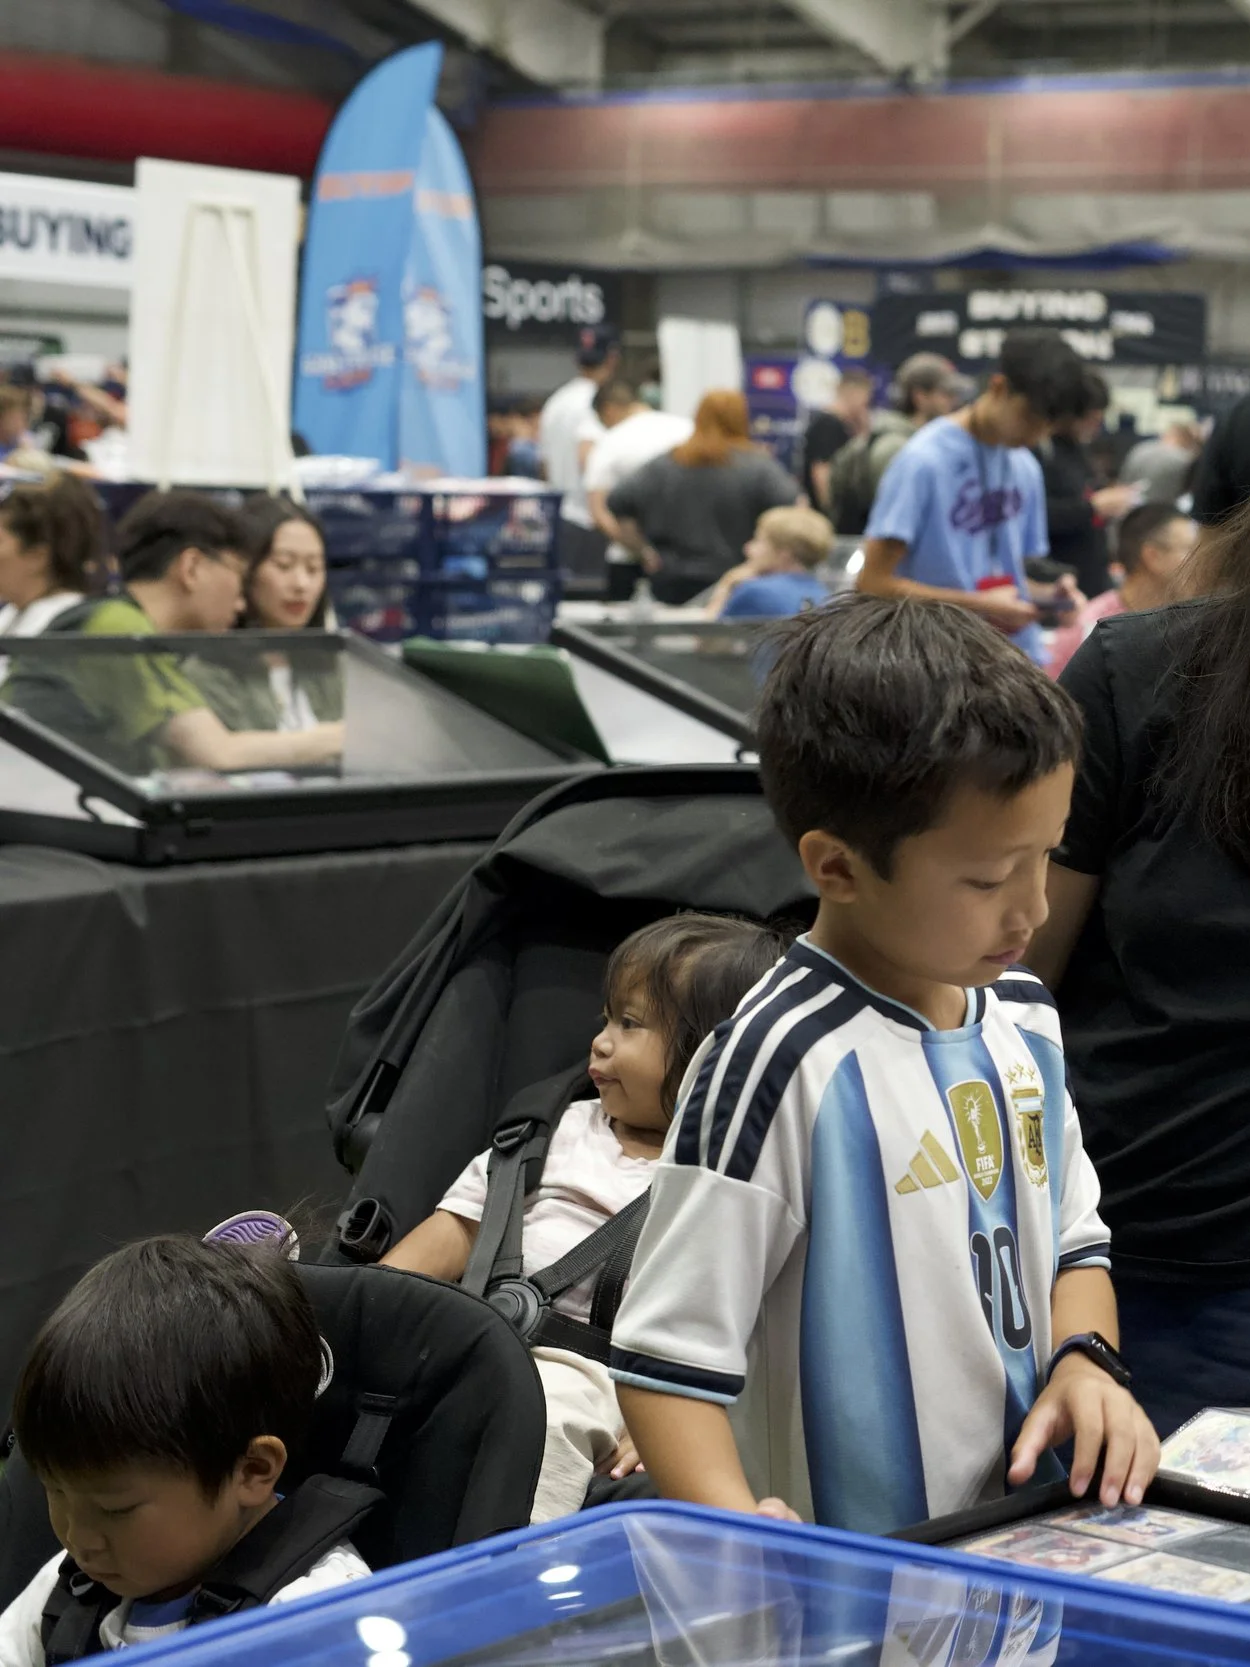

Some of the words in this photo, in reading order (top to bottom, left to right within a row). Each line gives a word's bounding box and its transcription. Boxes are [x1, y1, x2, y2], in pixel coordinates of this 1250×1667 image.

[0, 203, 133, 260] UYING
[484, 265, 605, 331] Sports
[975, 1154, 995, 1172] FIFA
[971, 1226, 1032, 1350] 10
